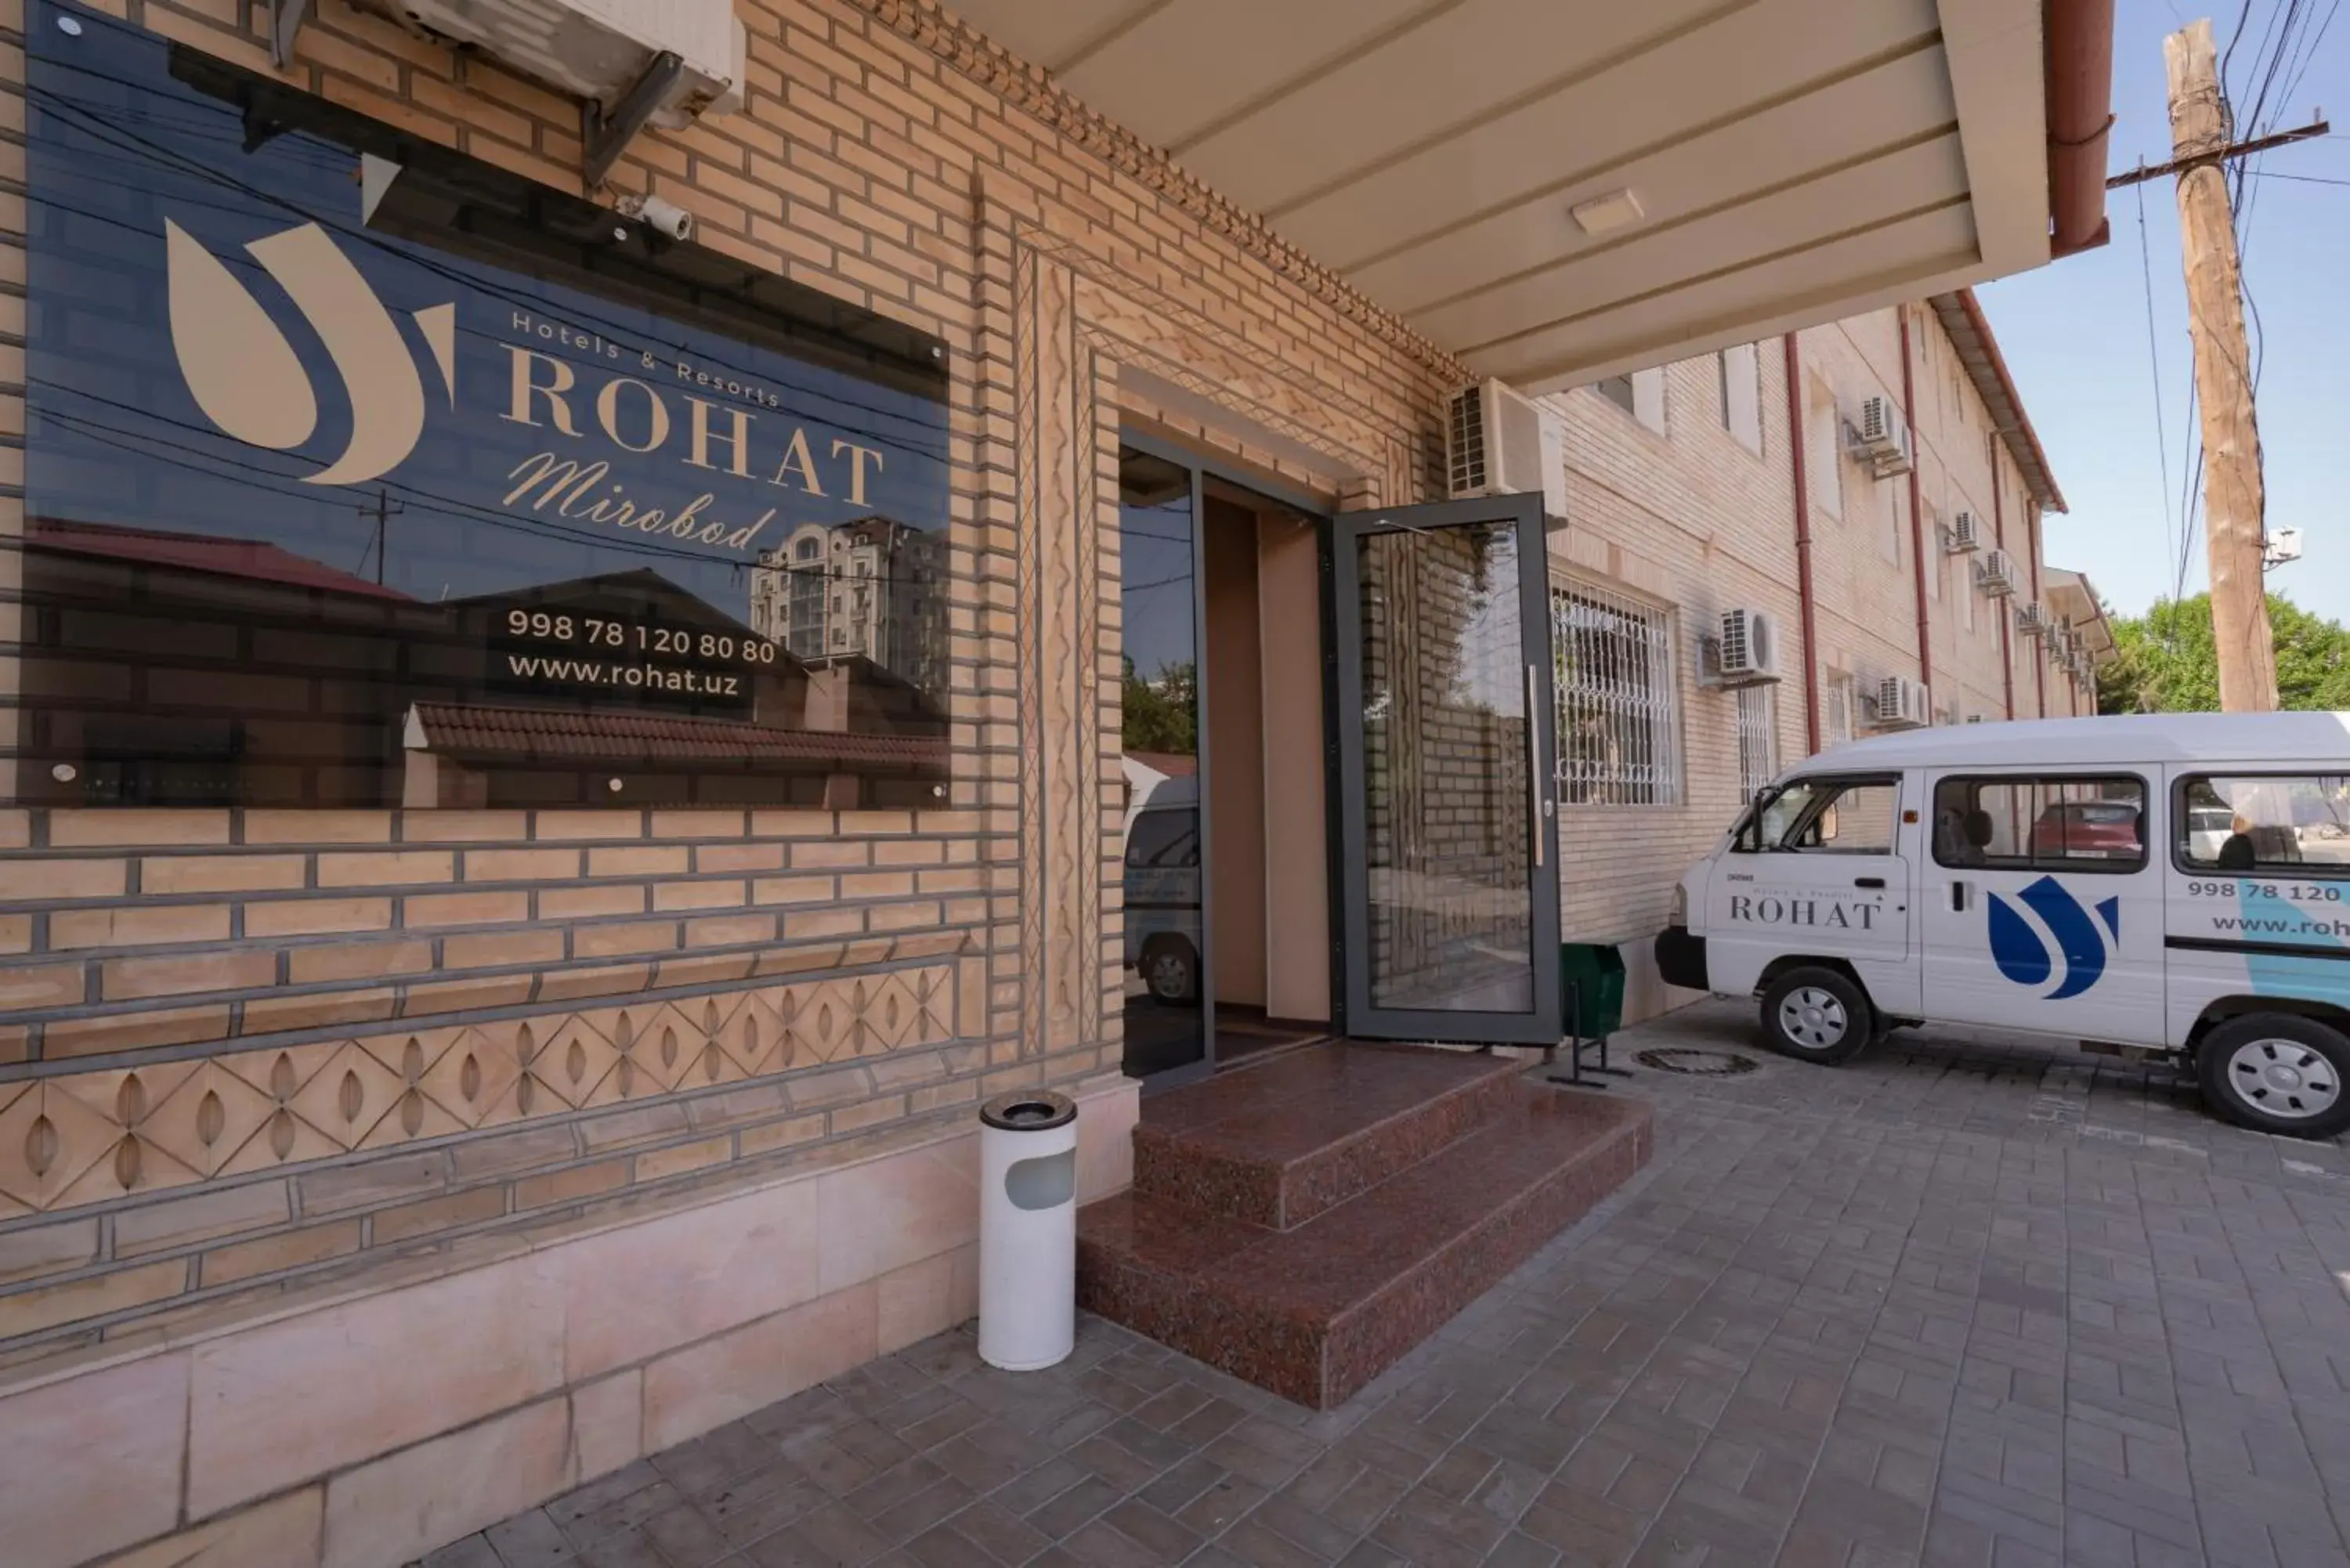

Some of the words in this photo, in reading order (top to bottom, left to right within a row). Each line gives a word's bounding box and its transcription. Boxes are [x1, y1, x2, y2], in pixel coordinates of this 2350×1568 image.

[512, 311, 620, 359] Hotels
[641, 351, 656, 370] &
[678, 362, 779, 407] Resorts
[499, 342, 884, 508] ROHAT
[502, 451, 776, 549] Mirobod
[508, 610, 573, 640] 998
[584, 619, 624, 646] 78
[636, 626, 690, 654] 120
[699, 635, 733, 659] 80
[742, 641, 775, 663] 80
[508, 655, 739, 696] www.rohat.uz
[1730, 894, 1881, 930] ROHAT
[2188, 881, 2236, 897] 998
[2246, 883, 2278, 899] 78
[2290, 886, 2341, 901] 120
